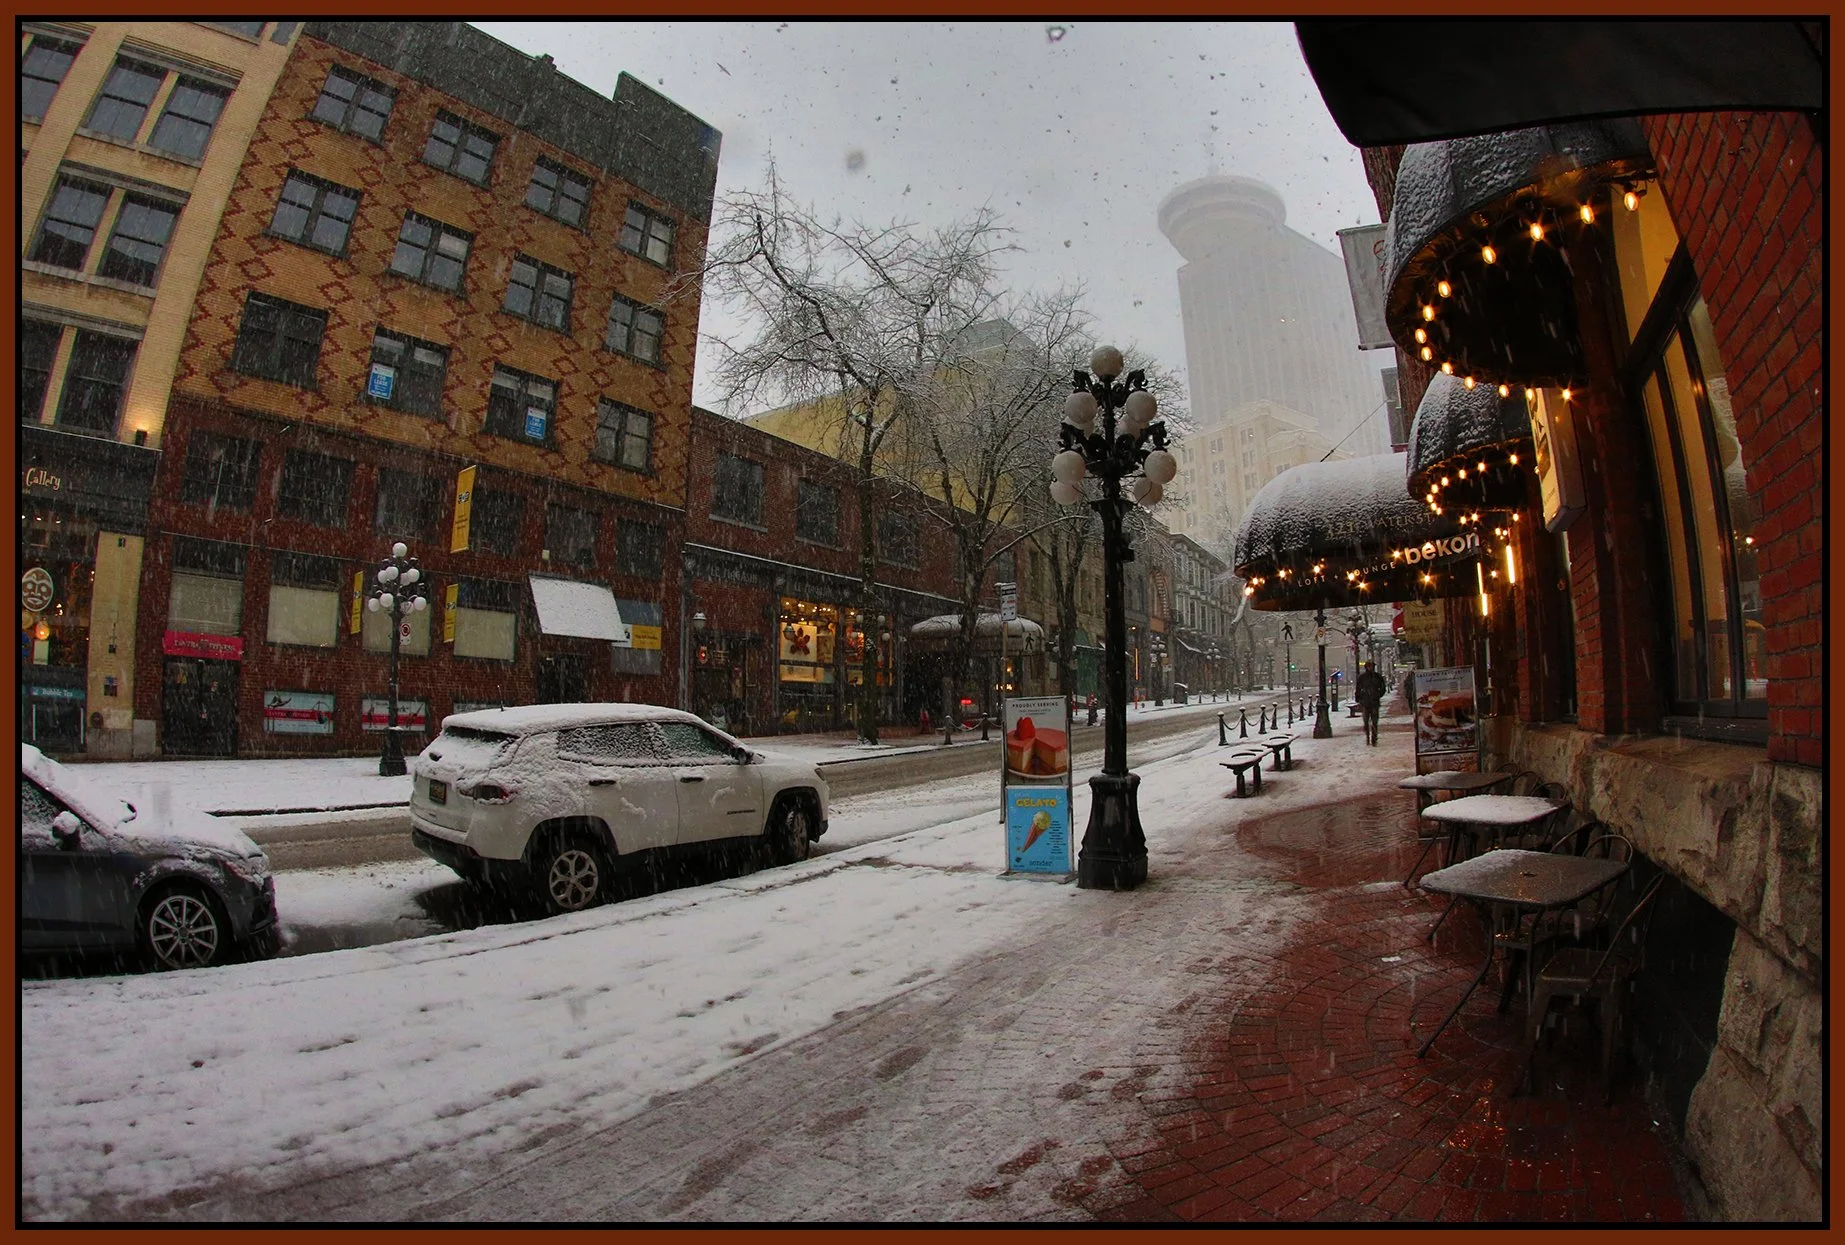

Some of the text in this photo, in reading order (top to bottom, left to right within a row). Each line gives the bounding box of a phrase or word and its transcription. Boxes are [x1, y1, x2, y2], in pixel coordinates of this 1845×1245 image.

[26, 467, 61, 490] Gallery
[1297, 575, 1326, 588] LOFT
[1346, 562, 1397, 579] LOUNGE
[1404, 532, 1480, 565] bekon
[1016, 798, 1057, 807] GELATO
